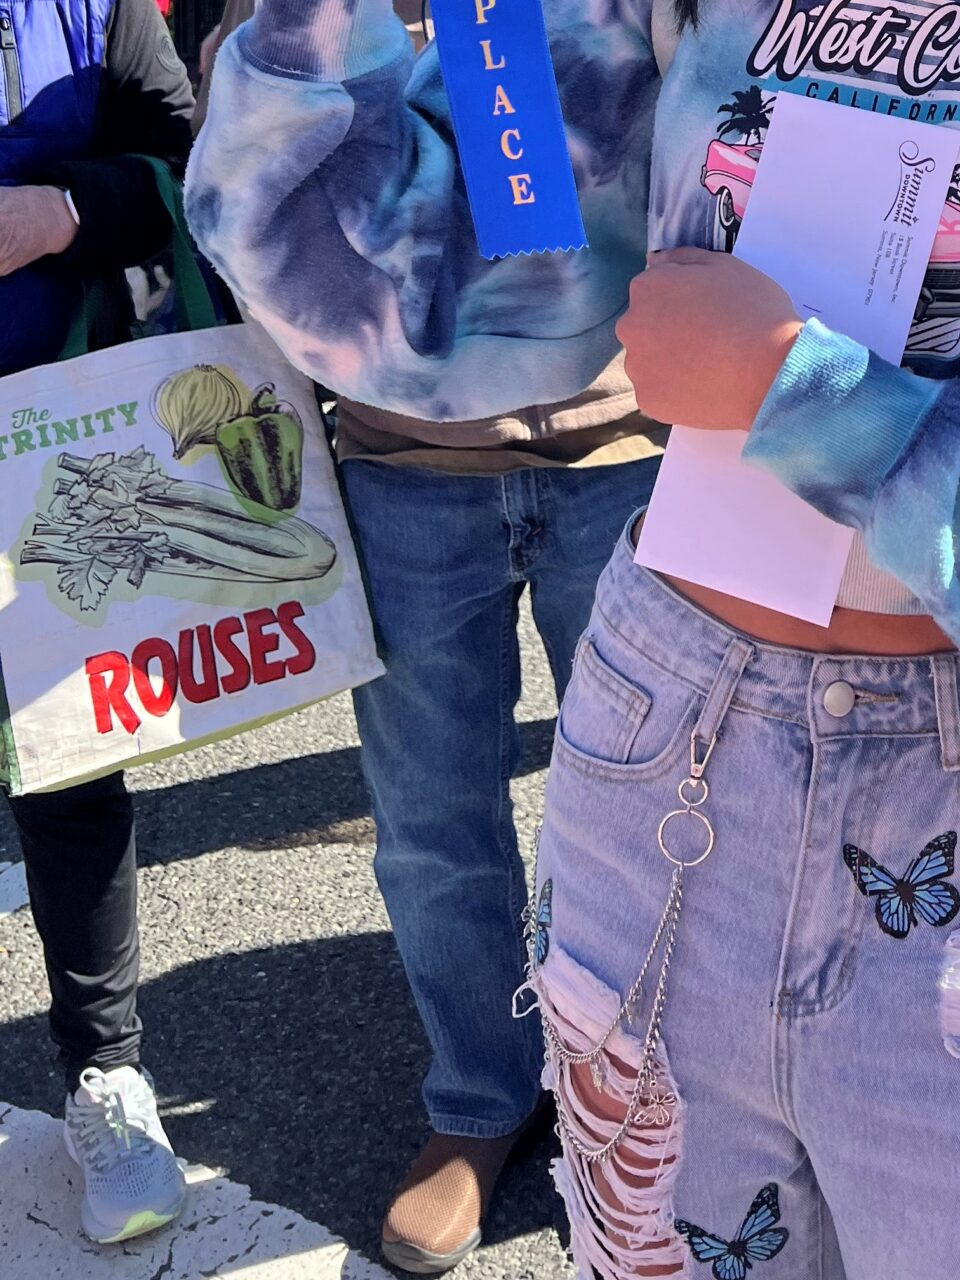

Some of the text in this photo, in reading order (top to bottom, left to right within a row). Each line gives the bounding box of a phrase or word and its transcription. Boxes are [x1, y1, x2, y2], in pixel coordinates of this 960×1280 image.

[893, 173, 911, 222] DOWNTOWN
[898, 140, 936, 228] Summit
[0, 400, 140, 462] TRINITY
[11, 406, 53, 430] The
[85, 600, 317, 735] ROUSES
